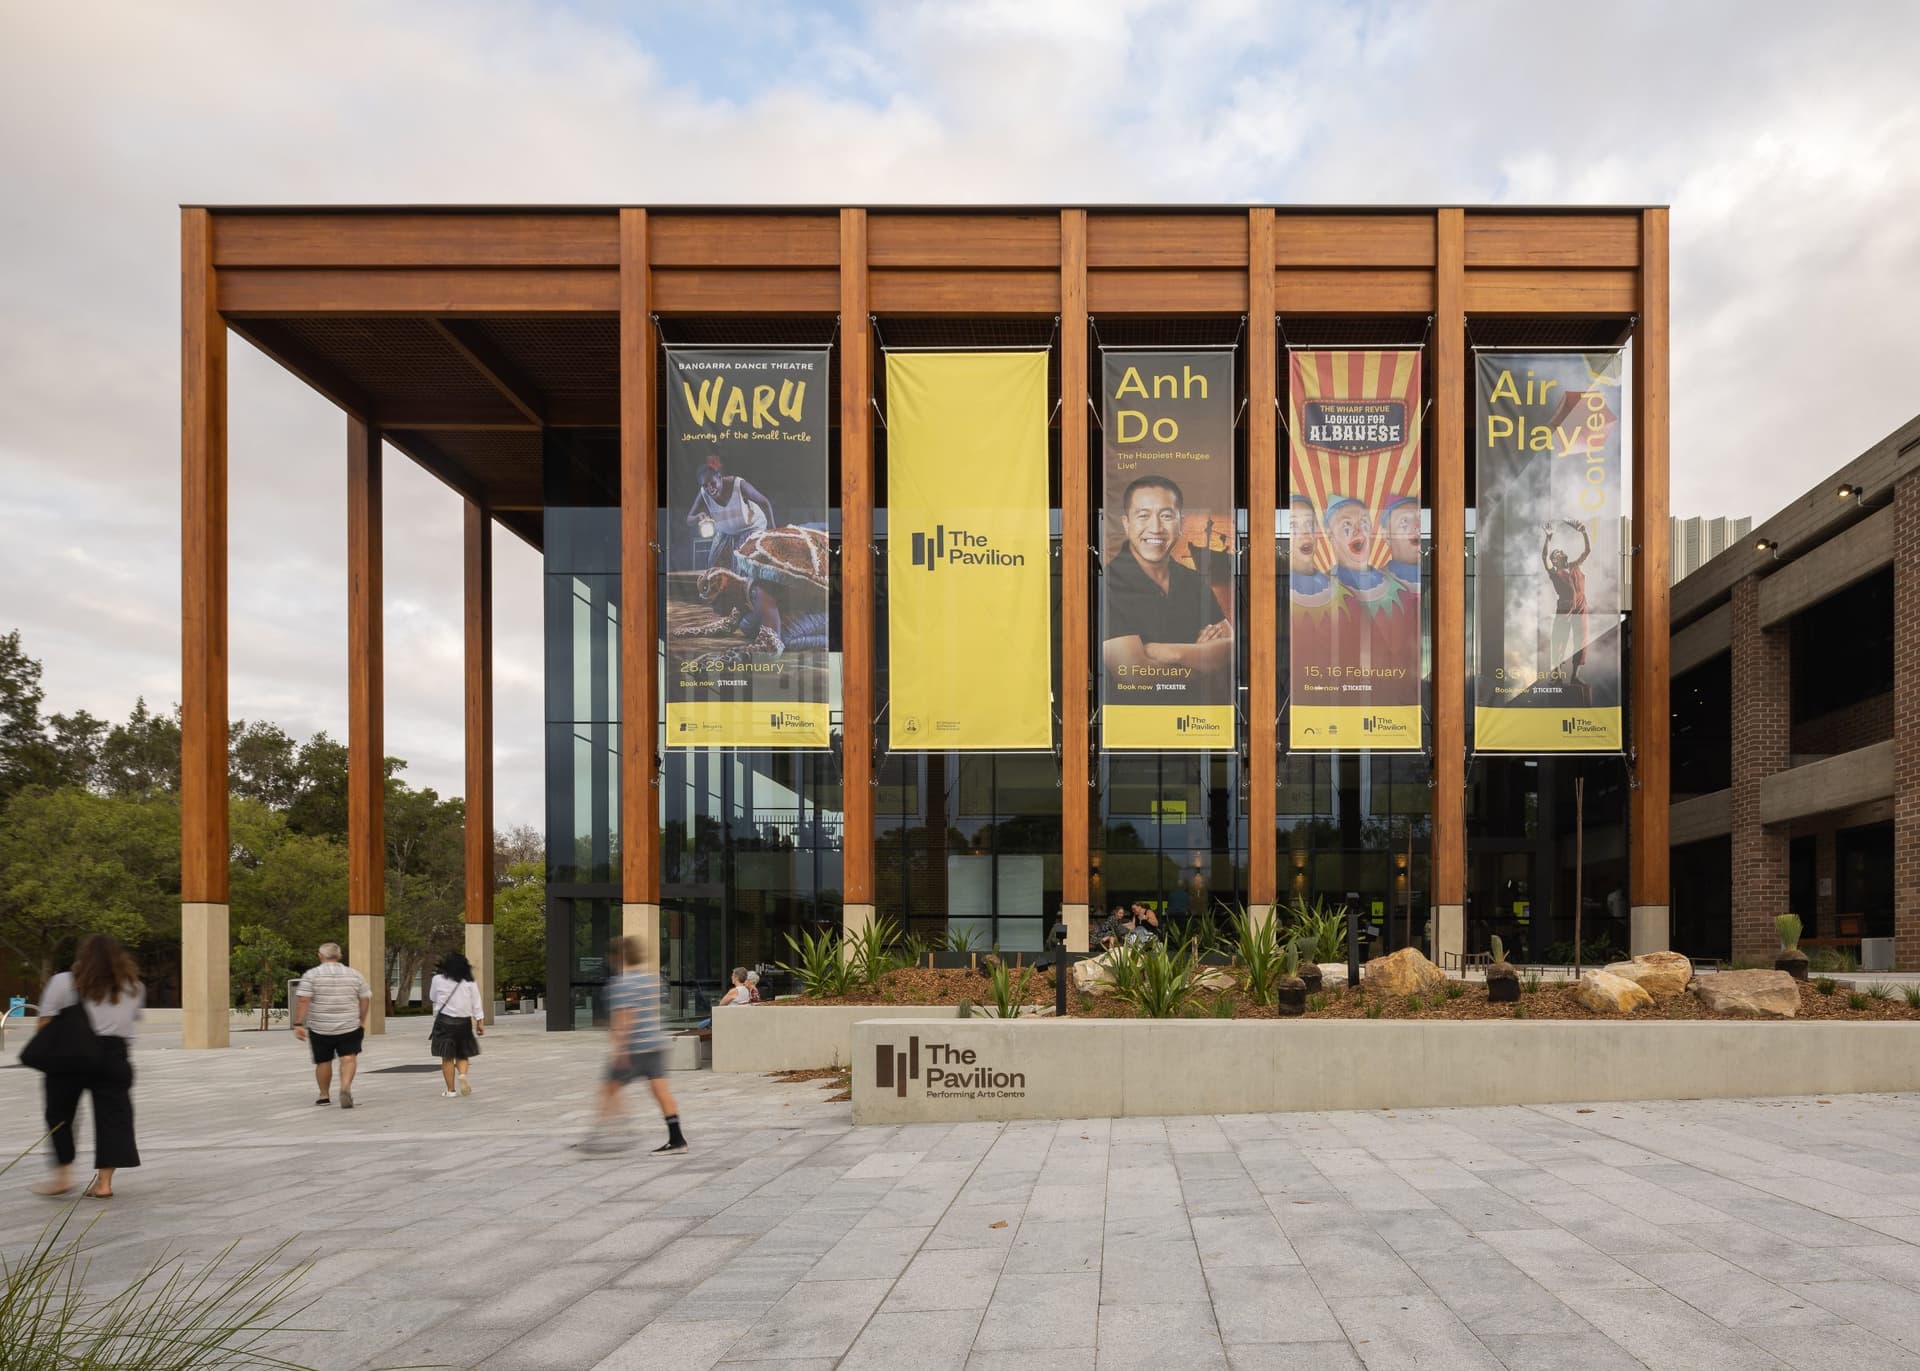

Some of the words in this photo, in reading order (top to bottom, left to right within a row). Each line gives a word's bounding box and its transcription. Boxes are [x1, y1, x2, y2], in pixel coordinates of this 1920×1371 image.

[678, 362, 732, 370] BANGARRA
[735, 362, 768, 370] DANCE
[771, 362, 814, 370] THEATRE
[1115, 365, 1208, 399] Anh
[1490, 370, 1558, 406] Air
[683, 375, 806, 429] WARU
[1320, 405, 1335, 413] THE
[1365, 405, 1390, 413] REVUE
[1325, 414, 1365, 424] LOOKING
[1367, 414, 1385, 424] FOR
[1117, 410, 1179, 444] Do
[1310, 424, 1400, 442] ALBANESE
[681, 431, 717, 443] Journey
[719, 430, 731, 440] of
[734, 431, 749, 440] the
[752, 430, 780, 441] Small
[782, 432, 812, 442] Turtle
[1487, 415, 1582, 457] Play
[1135, 451, 1173, 461] Happiest
[1175, 451, 1210, 461] Refugee
[1117, 462, 1137, 470] Live!
[948, 530, 988, 547] The
[949, 549, 1025, 567] Pavilion
[680, 661, 702, 674] 28,
[705, 661, 724, 672] 29
[728, 661, 784, 674] January
[1118, 665, 1128, 676] 8
[1131, 665, 1192, 677] February
[1305, 666, 1323, 678] 15,
[1328, 666, 1342, 677] 16
[1346, 666, 1406, 678] February
[1527, 669, 1568, 679] arch
[785, 720, 815, 728] Pavilion
[1191, 723, 1220, 731] Pavilion
[925, 1043, 977, 1065] The
[926, 1067, 1026, 1089] Pavilion
[926, 1090, 976, 1099] Performing
[976, 1090, 996, 1098] Arts
[996, 1090, 1026, 1098] Centre
